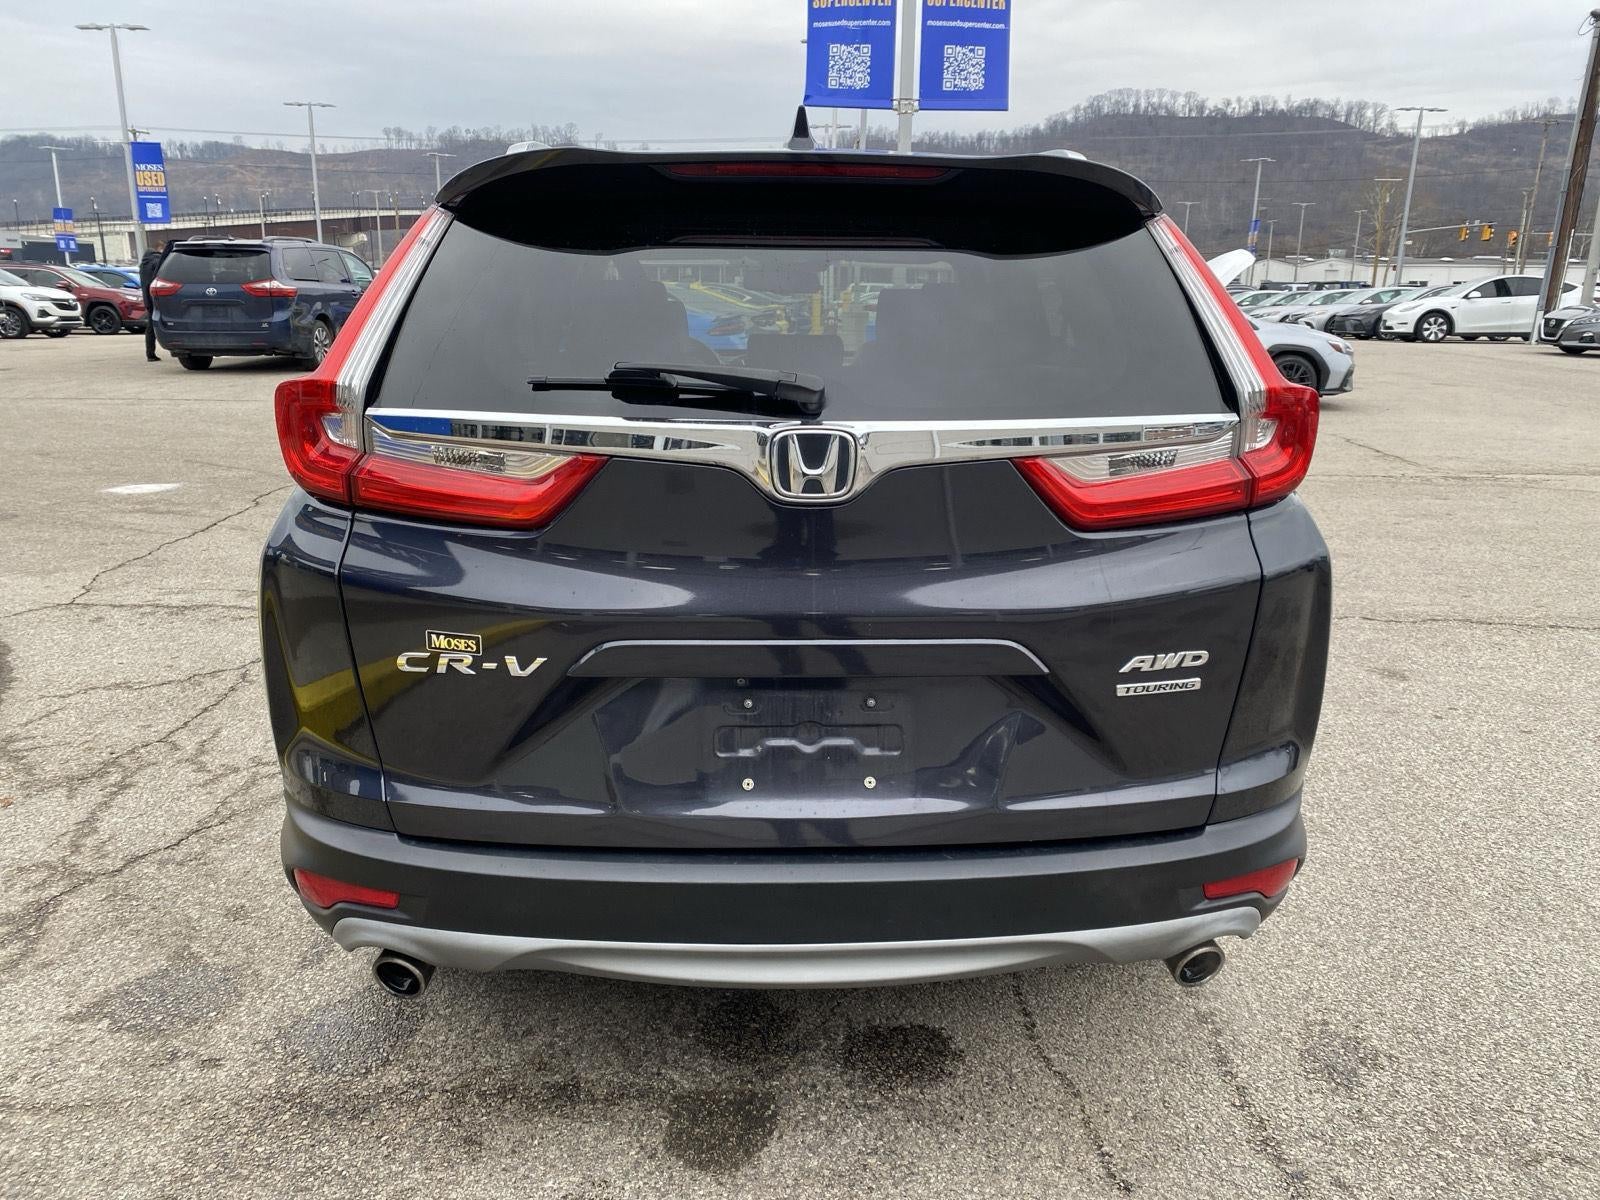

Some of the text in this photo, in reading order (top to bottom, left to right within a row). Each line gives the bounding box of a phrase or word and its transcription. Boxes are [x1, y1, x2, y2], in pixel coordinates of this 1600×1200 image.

[135, 163, 164, 171] MOSES
[135, 171, 165, 187] USED
[431, 633, 477, 652] MOSES
[397, 652, 548, 677] CR-V
[1119, 650, 1210, 673] AWD
[1124, 681, 1196, 694] TOURING
